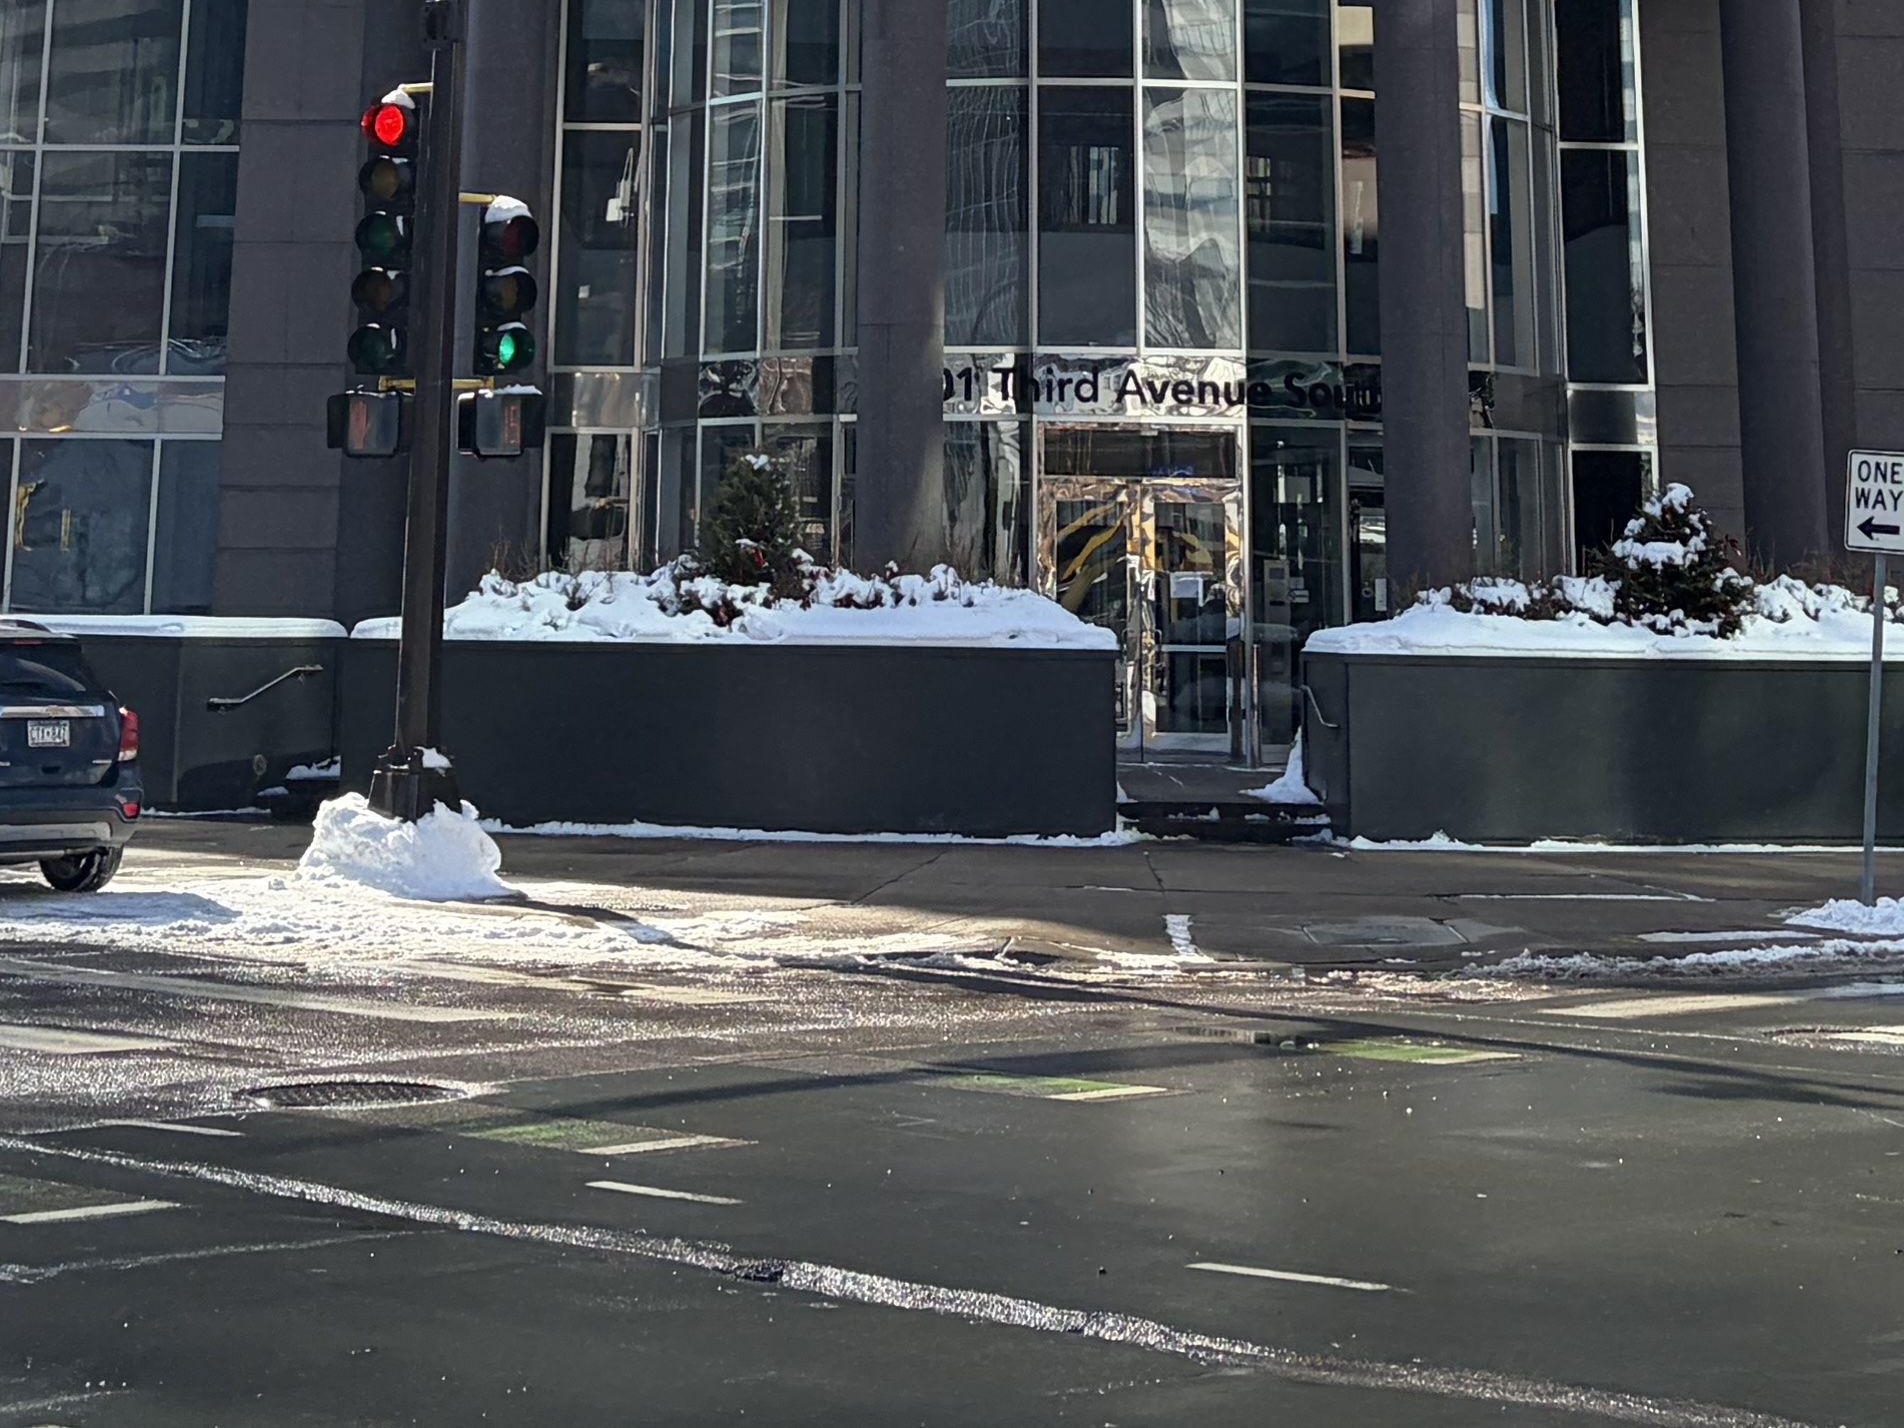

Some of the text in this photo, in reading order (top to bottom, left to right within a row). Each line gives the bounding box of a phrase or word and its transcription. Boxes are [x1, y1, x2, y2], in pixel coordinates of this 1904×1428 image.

[992, 365, 1098, 404] Third
[1115, 369, 1273, 407] Avenue
[1857, 460, 1904, 485] ONE
[1855, 486, 1904, 513] WAY
